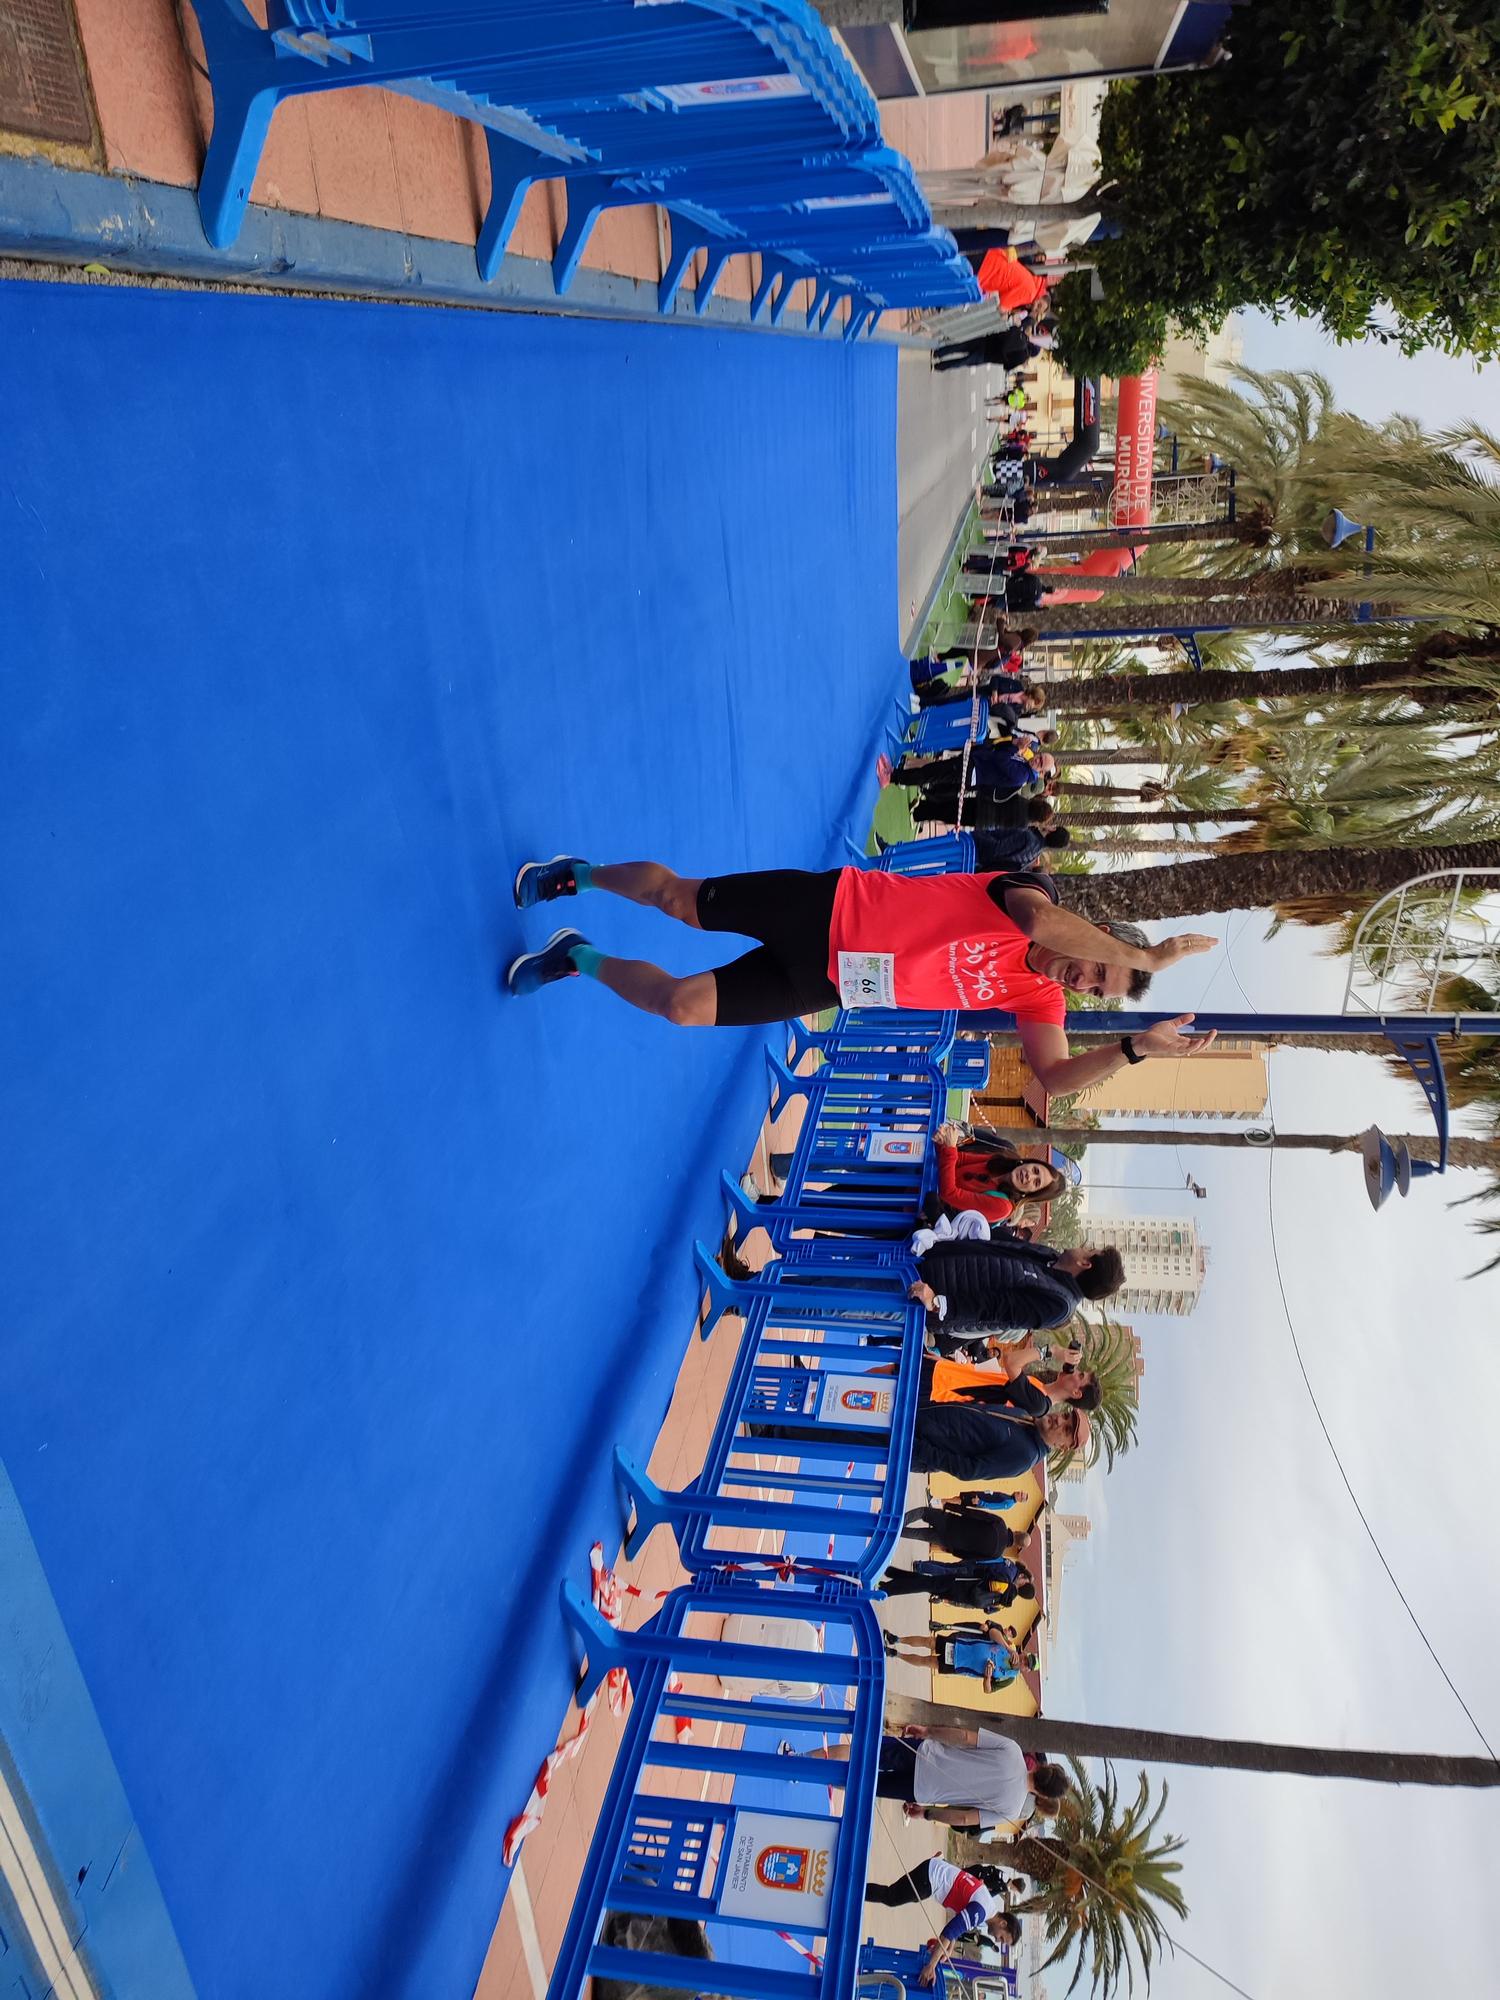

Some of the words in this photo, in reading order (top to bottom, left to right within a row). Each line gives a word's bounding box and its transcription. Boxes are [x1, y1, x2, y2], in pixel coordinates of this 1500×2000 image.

[1136, 367, 1154, 480] NIVERSIDAD
[1116, 435, 1132, 510] MURCIA
[1134, 486, 1148, 509] DE
[963, 942, 986, 964] 30
[862, 978, 876, 994] 66
[961, 968, 994, 1000] 740
[739, 1836, 747, 1846] DE
[736, 1847, 744, 1862] SAN
[738, 1836, 754, 1892] AYUNTAMIENTO
[731, 1864, 740, 1890] JAVIER
